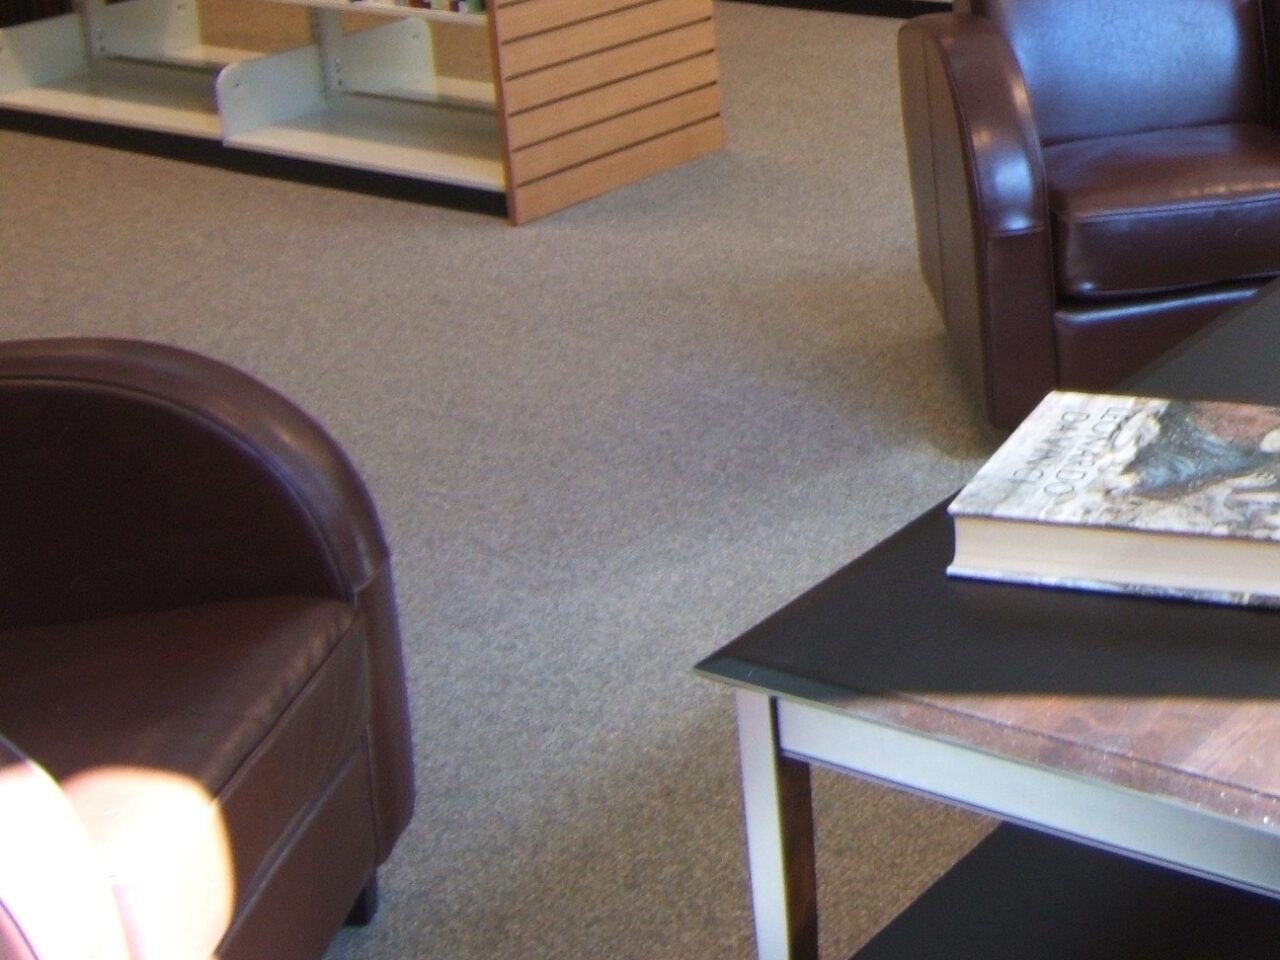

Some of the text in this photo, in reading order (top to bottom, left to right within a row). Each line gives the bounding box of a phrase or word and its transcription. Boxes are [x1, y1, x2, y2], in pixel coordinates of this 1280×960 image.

[1007, 411, 1090, 486] DA VINCI
[1044, 406, 1132, 497] LEONARDO
